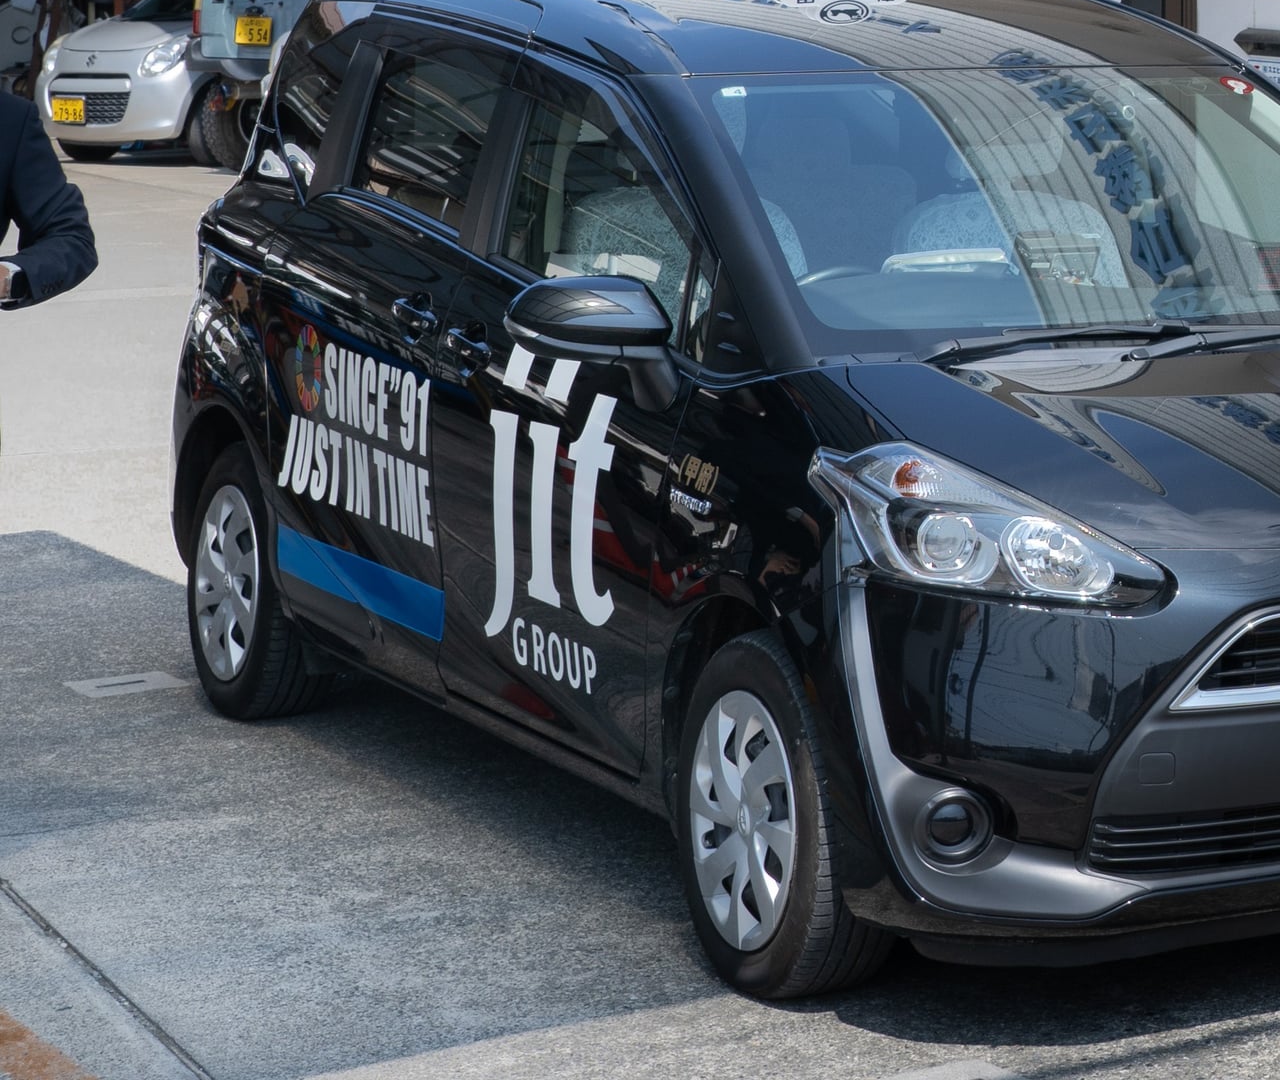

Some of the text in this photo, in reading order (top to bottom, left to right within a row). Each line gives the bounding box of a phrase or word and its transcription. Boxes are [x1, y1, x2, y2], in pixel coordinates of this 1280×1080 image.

[278, 414, 435, 548] JUST IN TIME
[512, 617, 597, 695] GROUP
